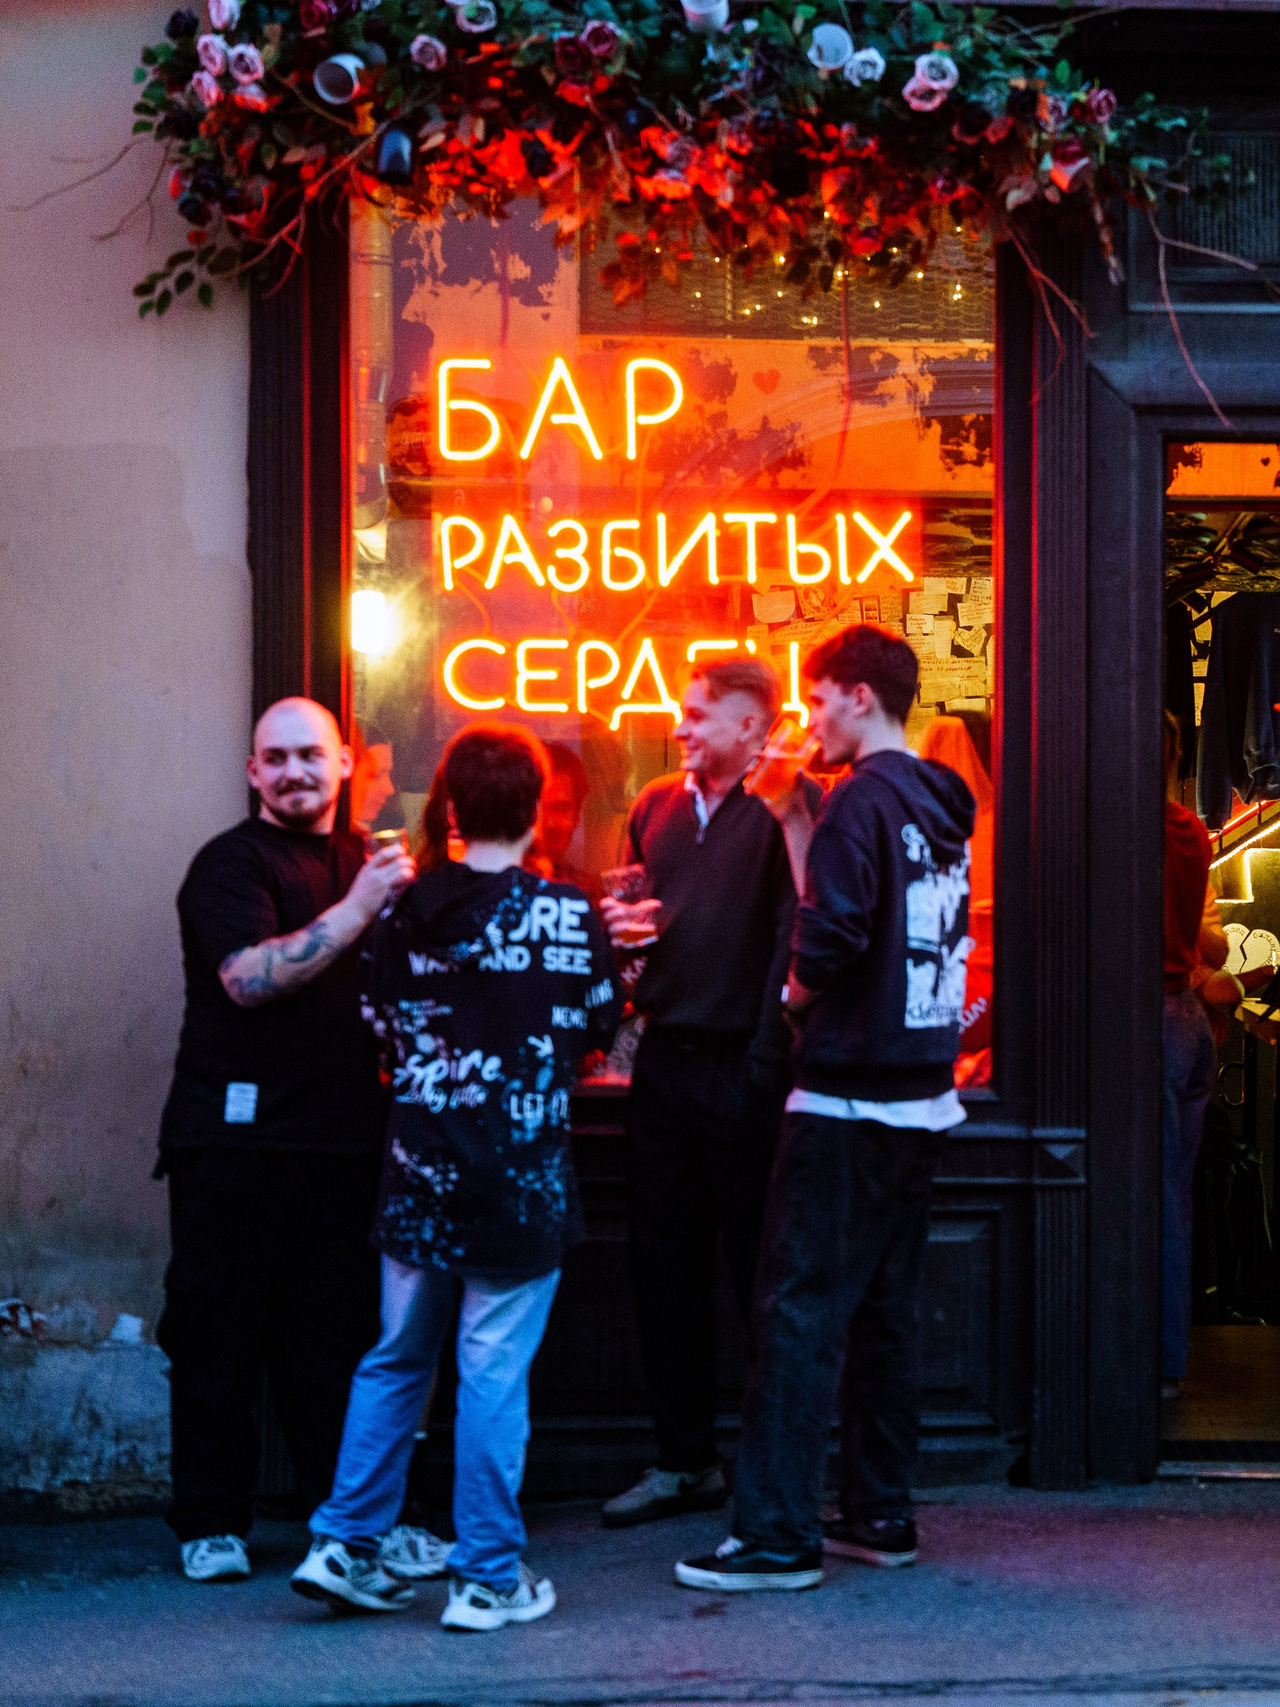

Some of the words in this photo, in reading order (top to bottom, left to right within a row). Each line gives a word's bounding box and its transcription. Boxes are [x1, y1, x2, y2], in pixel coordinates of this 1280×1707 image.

[437, 356, 685, 463] БАР
[439, 510, 915, 594] РАЗБИТЫХ
[542, 945, 592, 975] SEE
